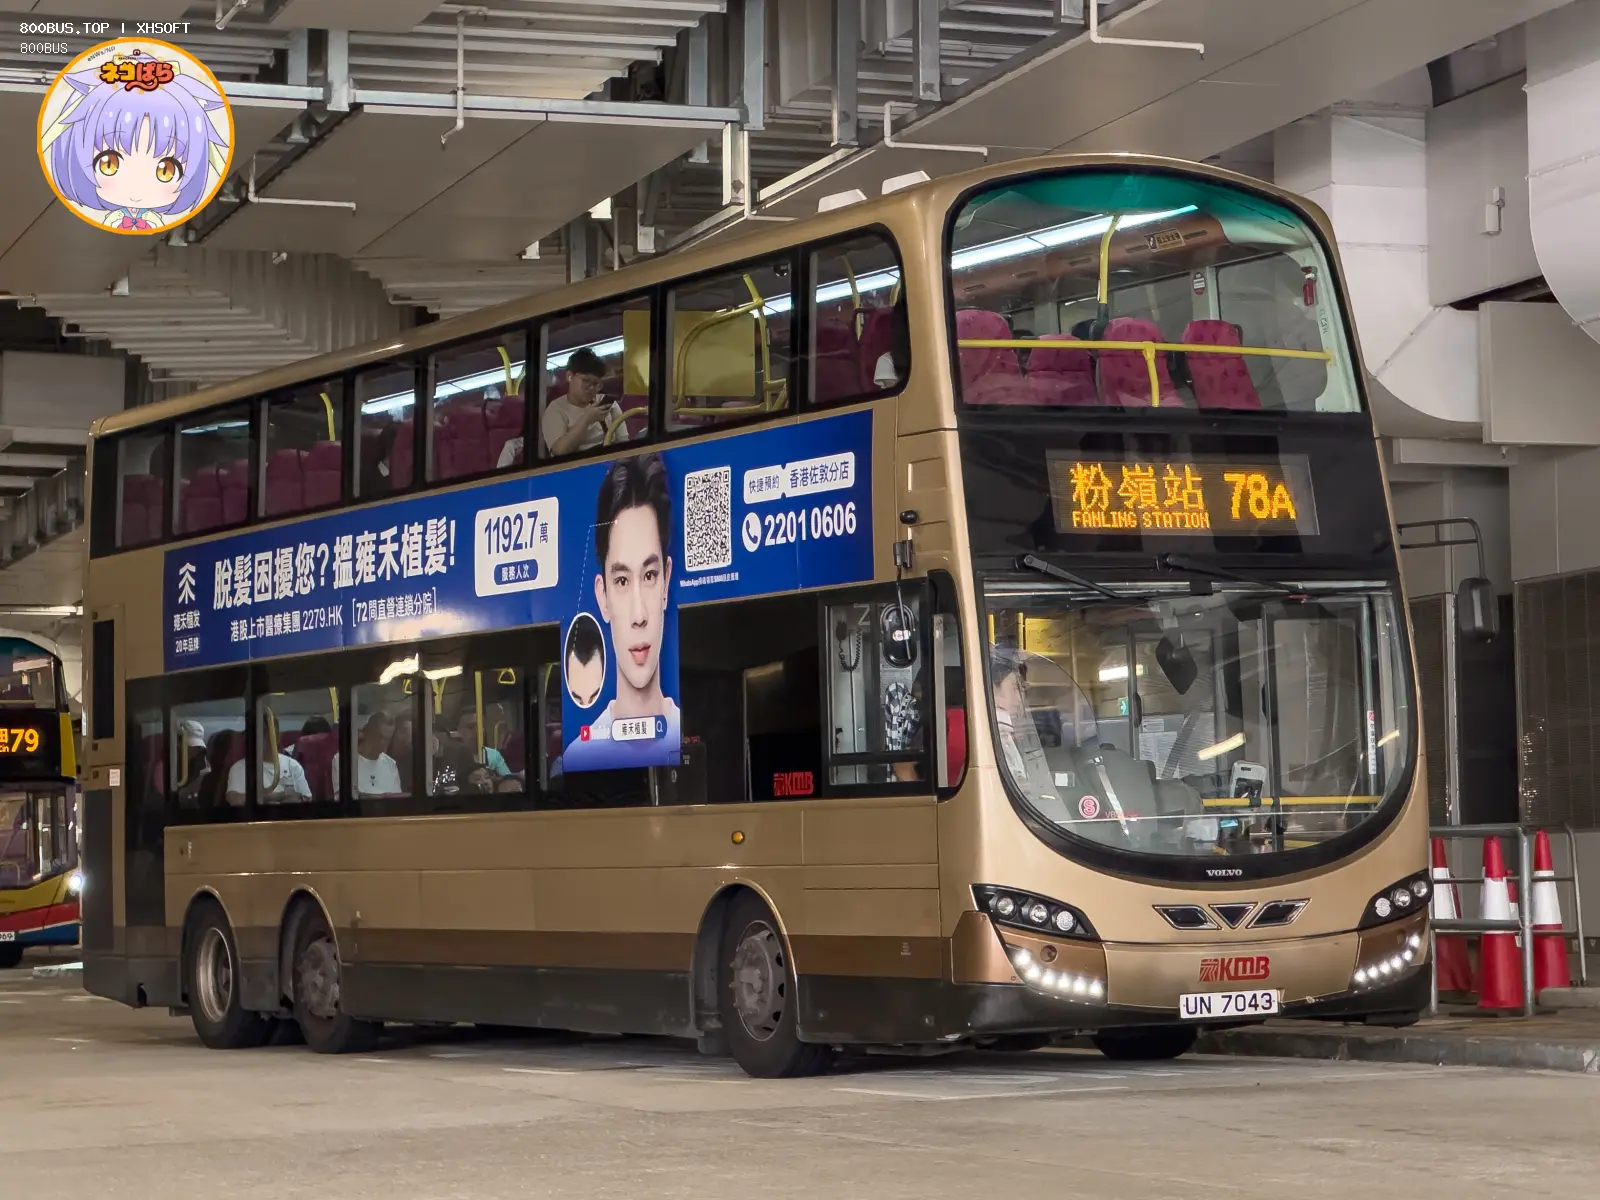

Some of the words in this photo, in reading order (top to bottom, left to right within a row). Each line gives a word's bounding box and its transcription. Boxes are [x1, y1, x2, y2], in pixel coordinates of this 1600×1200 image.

[748, 475, 780, 494] 快捷預約
[789, 460, 850, 489] 香港佐敦分店
[1068, 461, 1206, 511] 粉嶺站
[1223, 471, 1298, 520] 78A
[764, 508, 807, 546] 2201
[811, 501, 857, 540] 0606
[1072, 510, 1138, 529] FANLING
[1143, 511, 1211, 529] STATION
[501, 563, 530, 582] 服務人次
[230, 610, 301, 643] 港股上市醫療集團
[302, 604, 343, 631] 2279.HK
[10, 728, 39, 753] 79
[1206, 869, 1243, 877] VOLVO
[1219, 955, 1271, 981] KMB
[1185, 995, 1212, 1015] UN
[1221, 992, 1273, 1014] 7043
